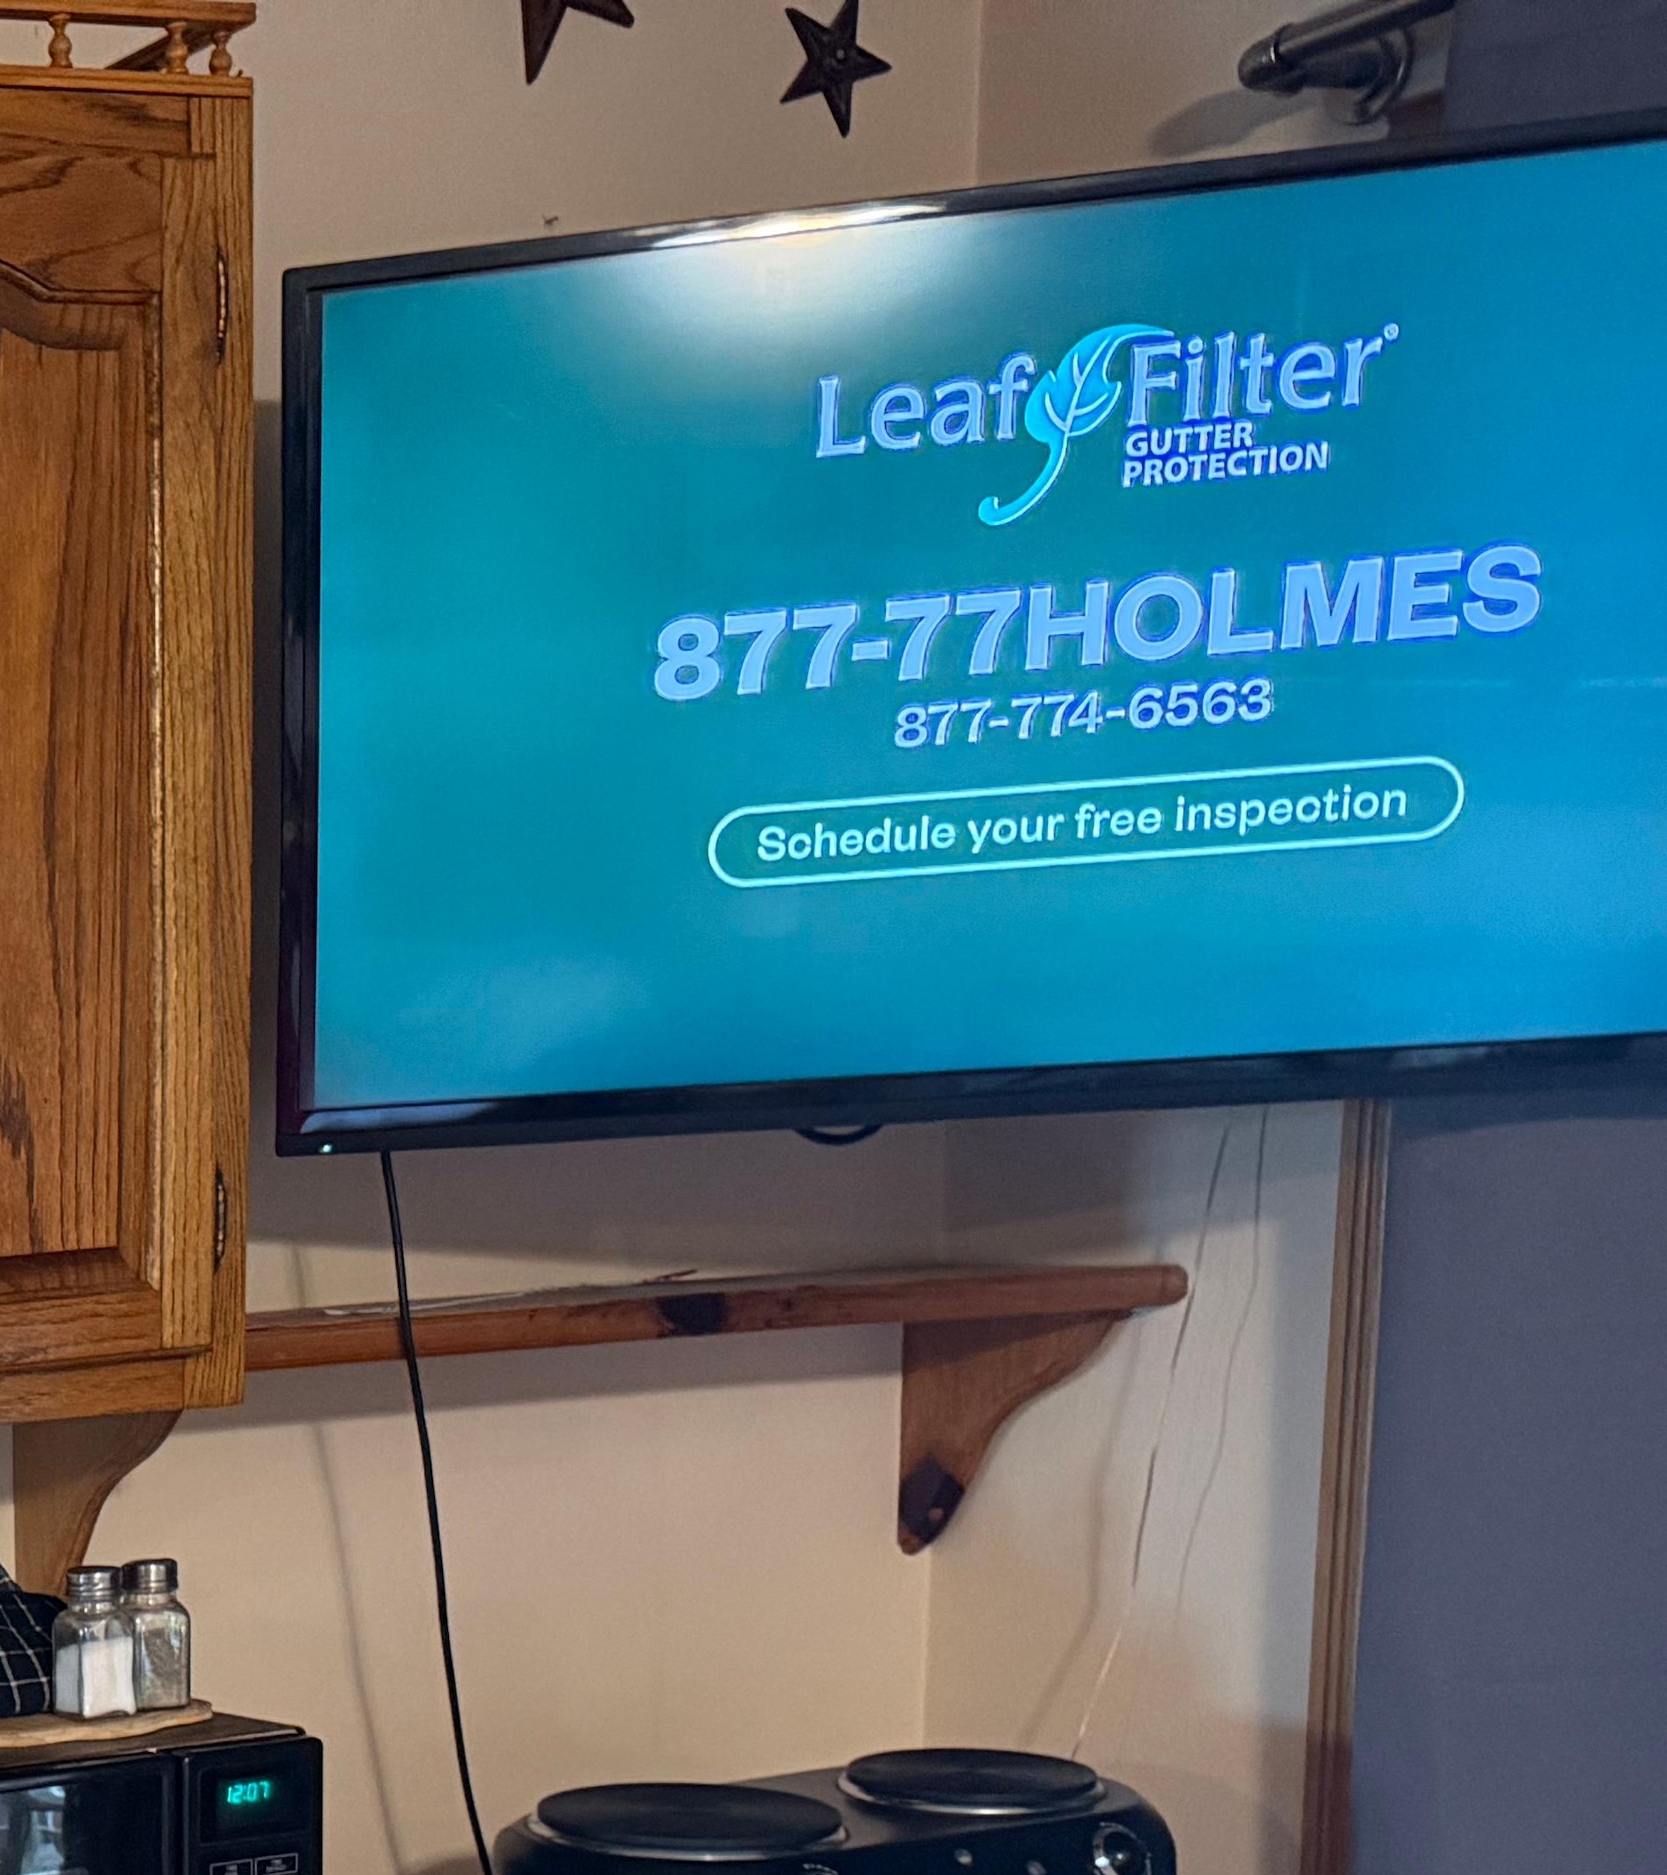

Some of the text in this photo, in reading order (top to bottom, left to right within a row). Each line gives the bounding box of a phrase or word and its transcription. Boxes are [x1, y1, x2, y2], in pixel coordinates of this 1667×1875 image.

[816, 329, 1385, 458] Leaf Filter
[1122, 441, 1330, 488] PROTECTION
[1125, 421, 1254, 459] GUTTER
[653, 541, 1543, 701] 877-77HOLMES
[893, 677, 1274, 749] 877-774-6563
[757, 784, 1408, 863] Schedule your free inspection
[227, 1781, 271, 1804] 12:07
